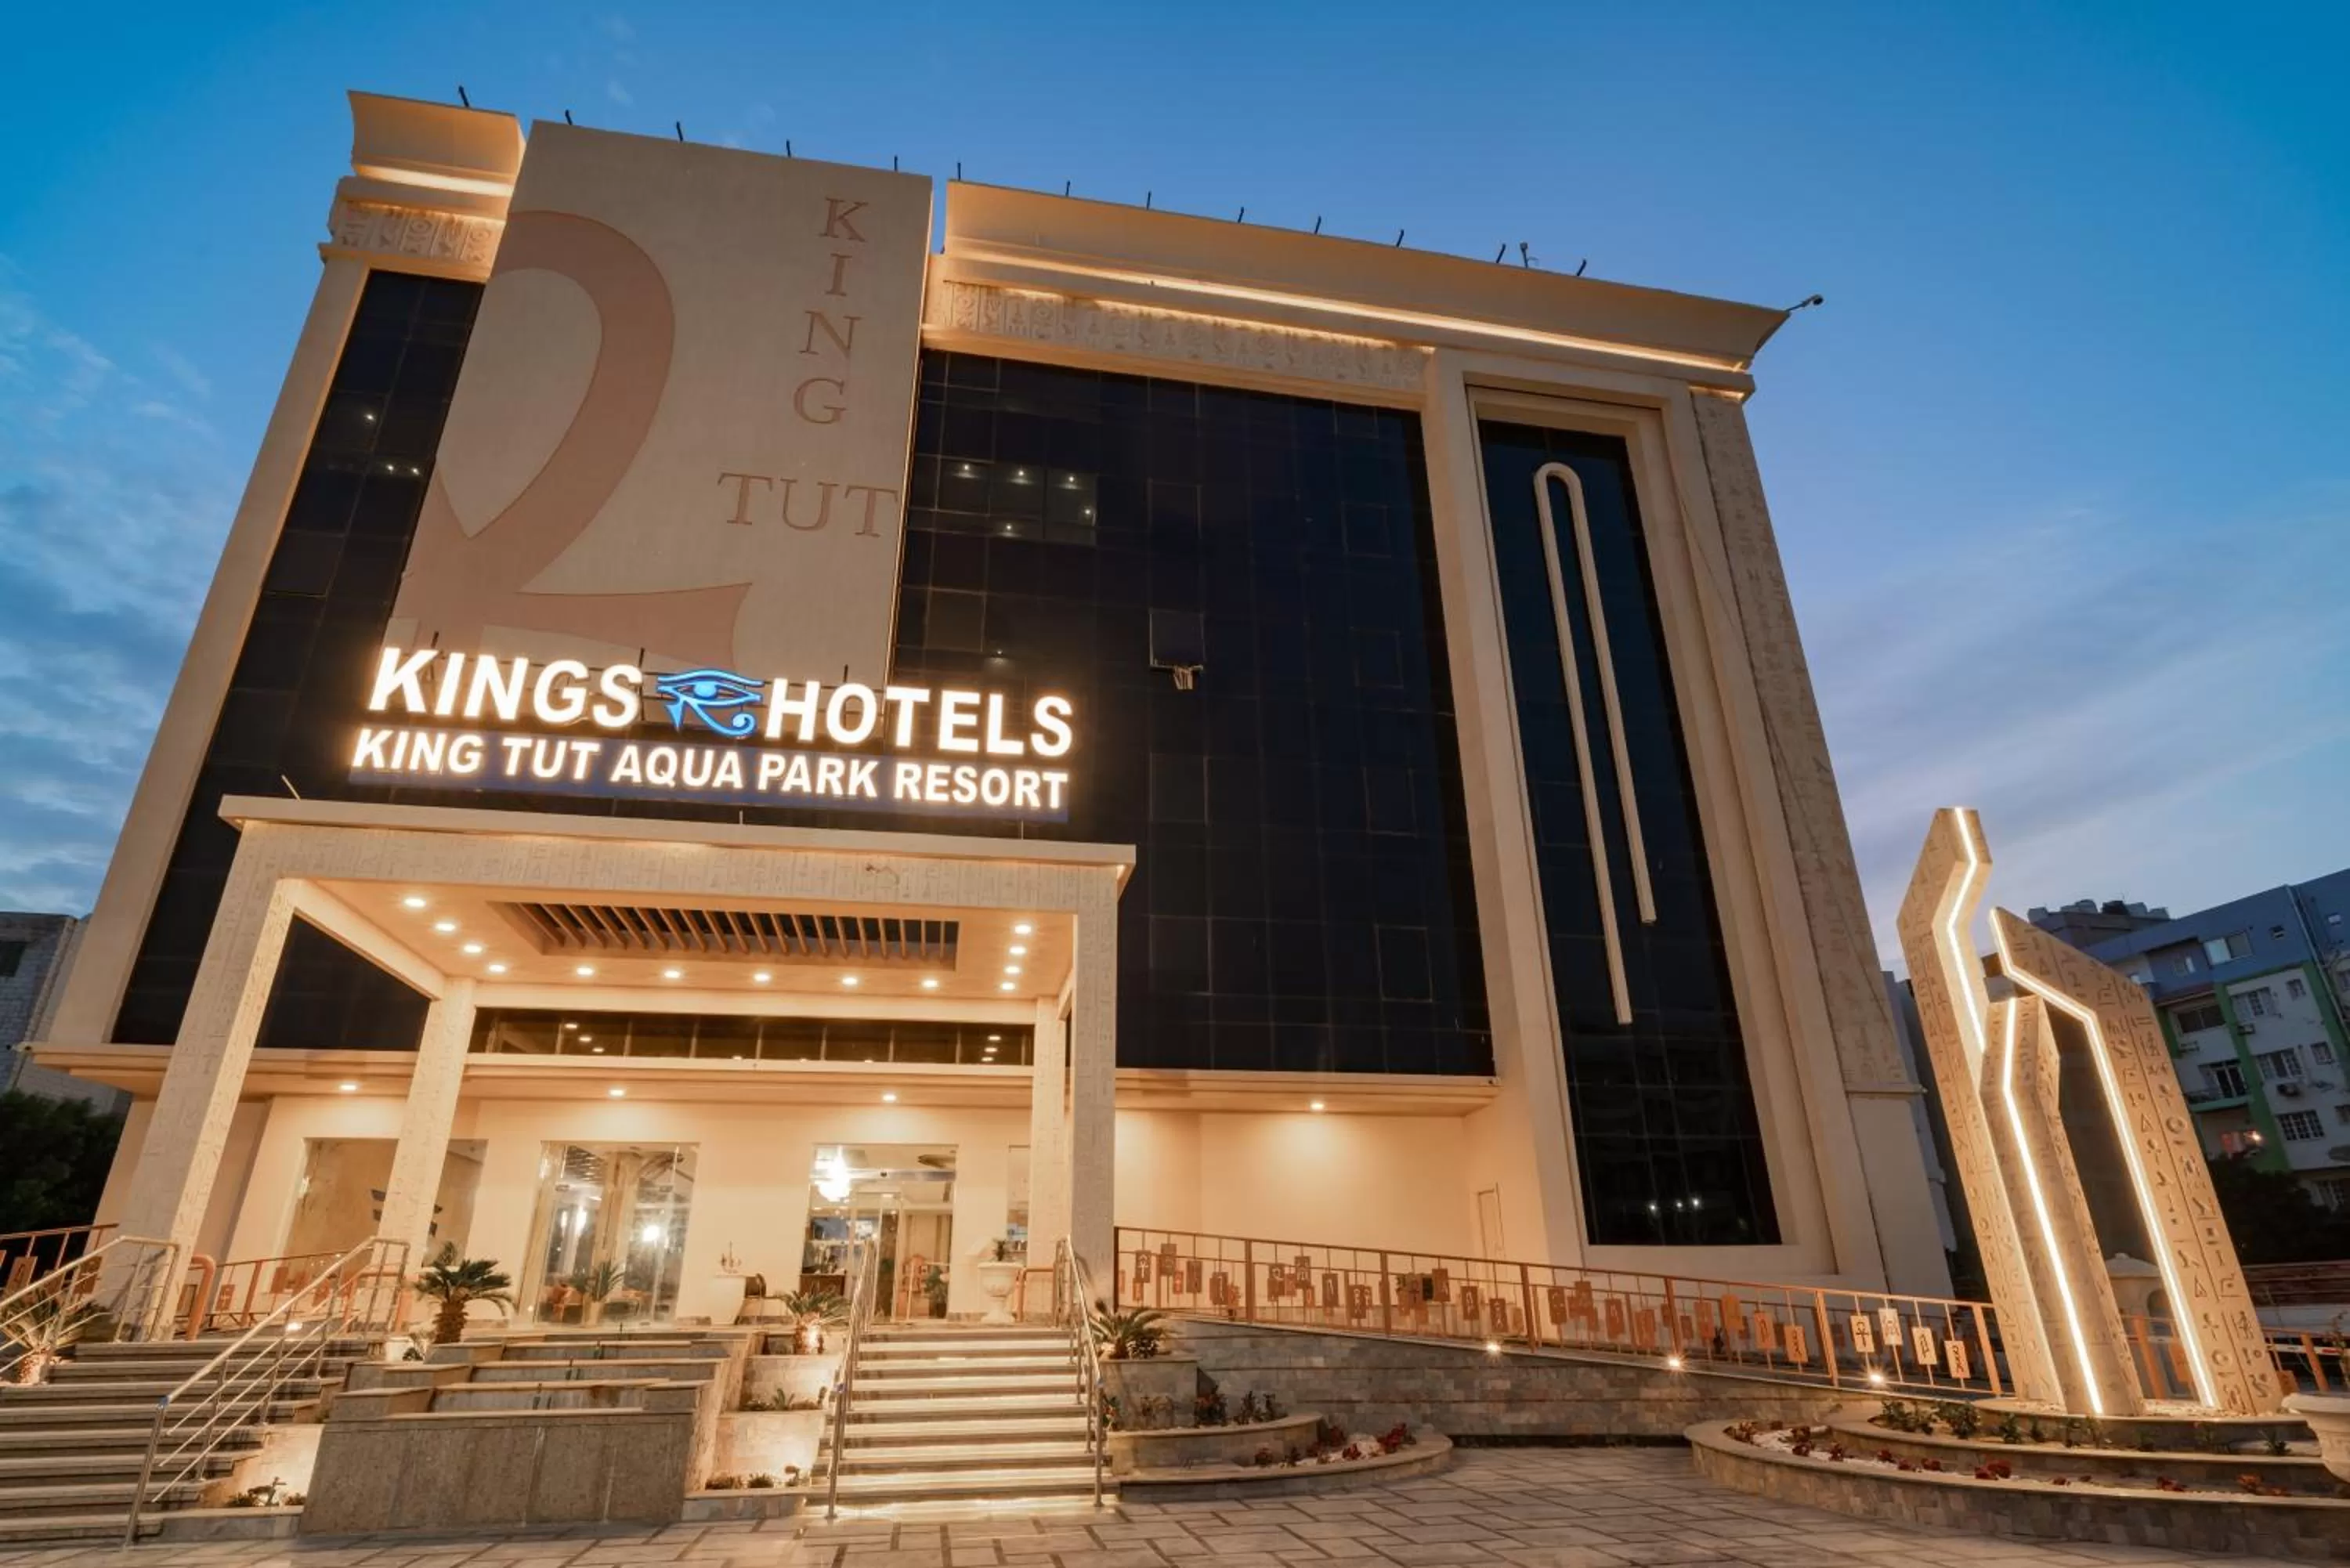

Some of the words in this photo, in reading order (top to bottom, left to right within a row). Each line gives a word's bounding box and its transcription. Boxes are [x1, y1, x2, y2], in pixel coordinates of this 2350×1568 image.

[792, 197, 870, 424] KING
[718, 471, 898, 538] TUT
[368, 647, 643, 728] KINGS
[764, 677, 1074, 757] HOTELS
[351, 728, 484, 774] KING
[501, 737, 602, 780] TUT
[610, 744, 743, 788] AQUA
[757, 753, 879, 799] PARK
[893, 763, 1069, 809] RESORT
